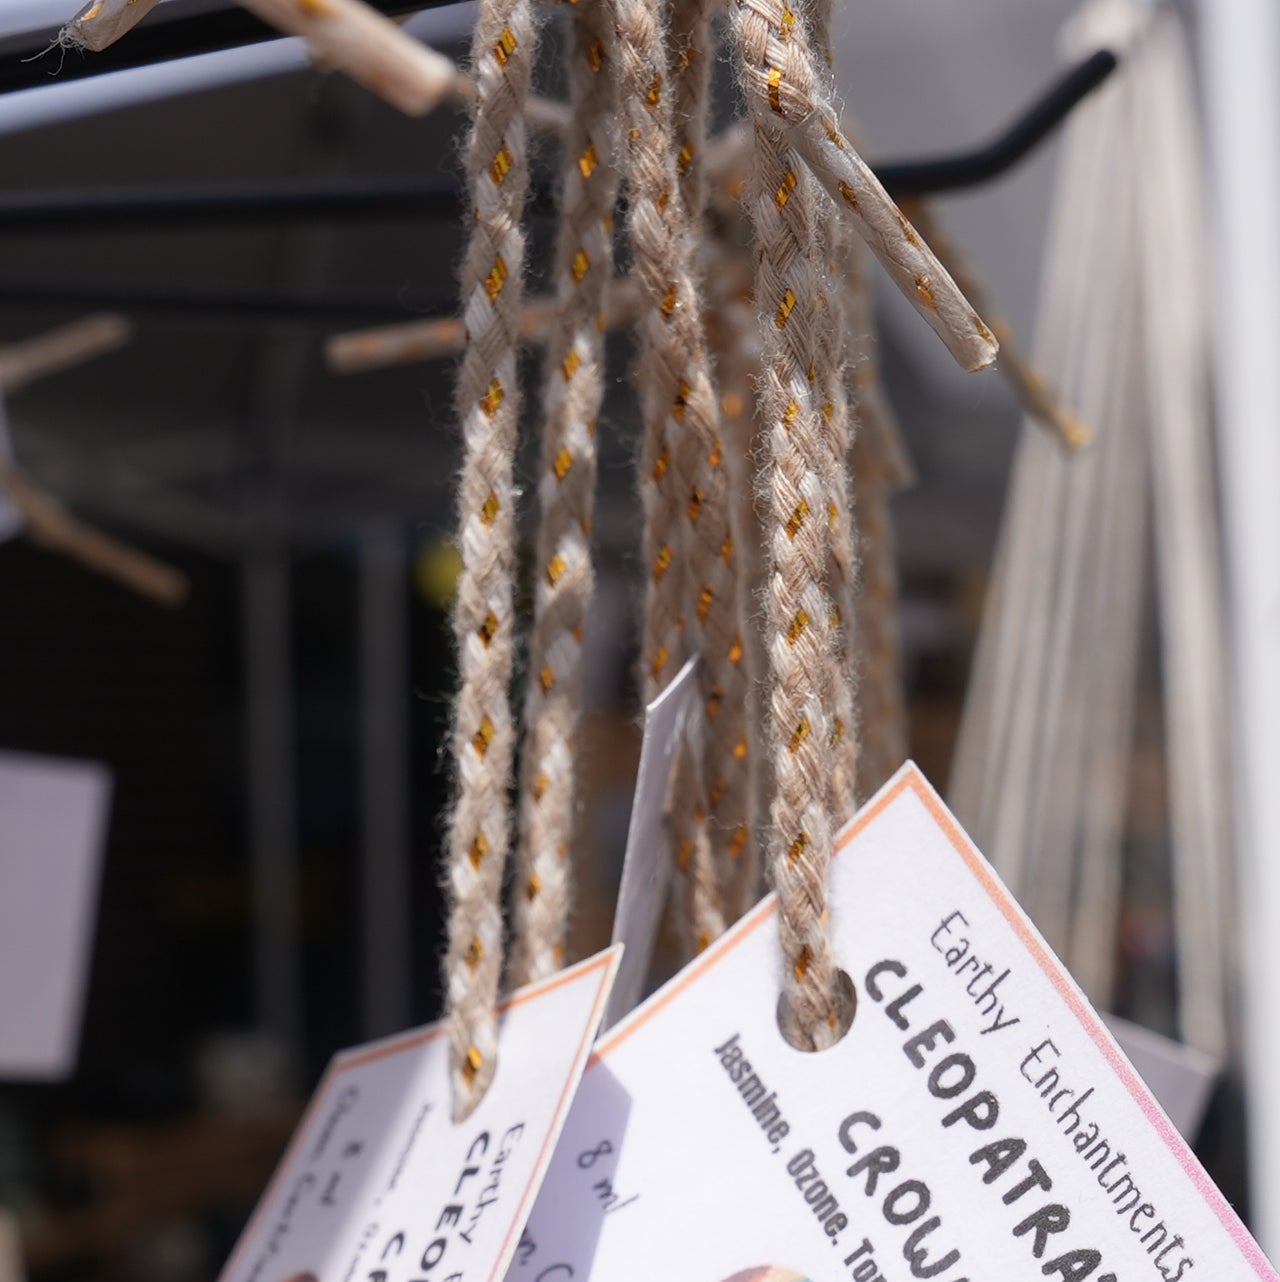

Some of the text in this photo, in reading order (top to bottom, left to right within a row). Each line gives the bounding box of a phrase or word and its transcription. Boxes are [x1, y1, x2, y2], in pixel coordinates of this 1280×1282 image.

[931, 910, 1020, 1035] Earthy
[460, 1122, 525, 1245] Earthy
[577, 1139, 640, 1214] 8 ml
[714, 1033, 790, 1154] Jasmine,
[786, 1148, 849, 1247] Ozone.
